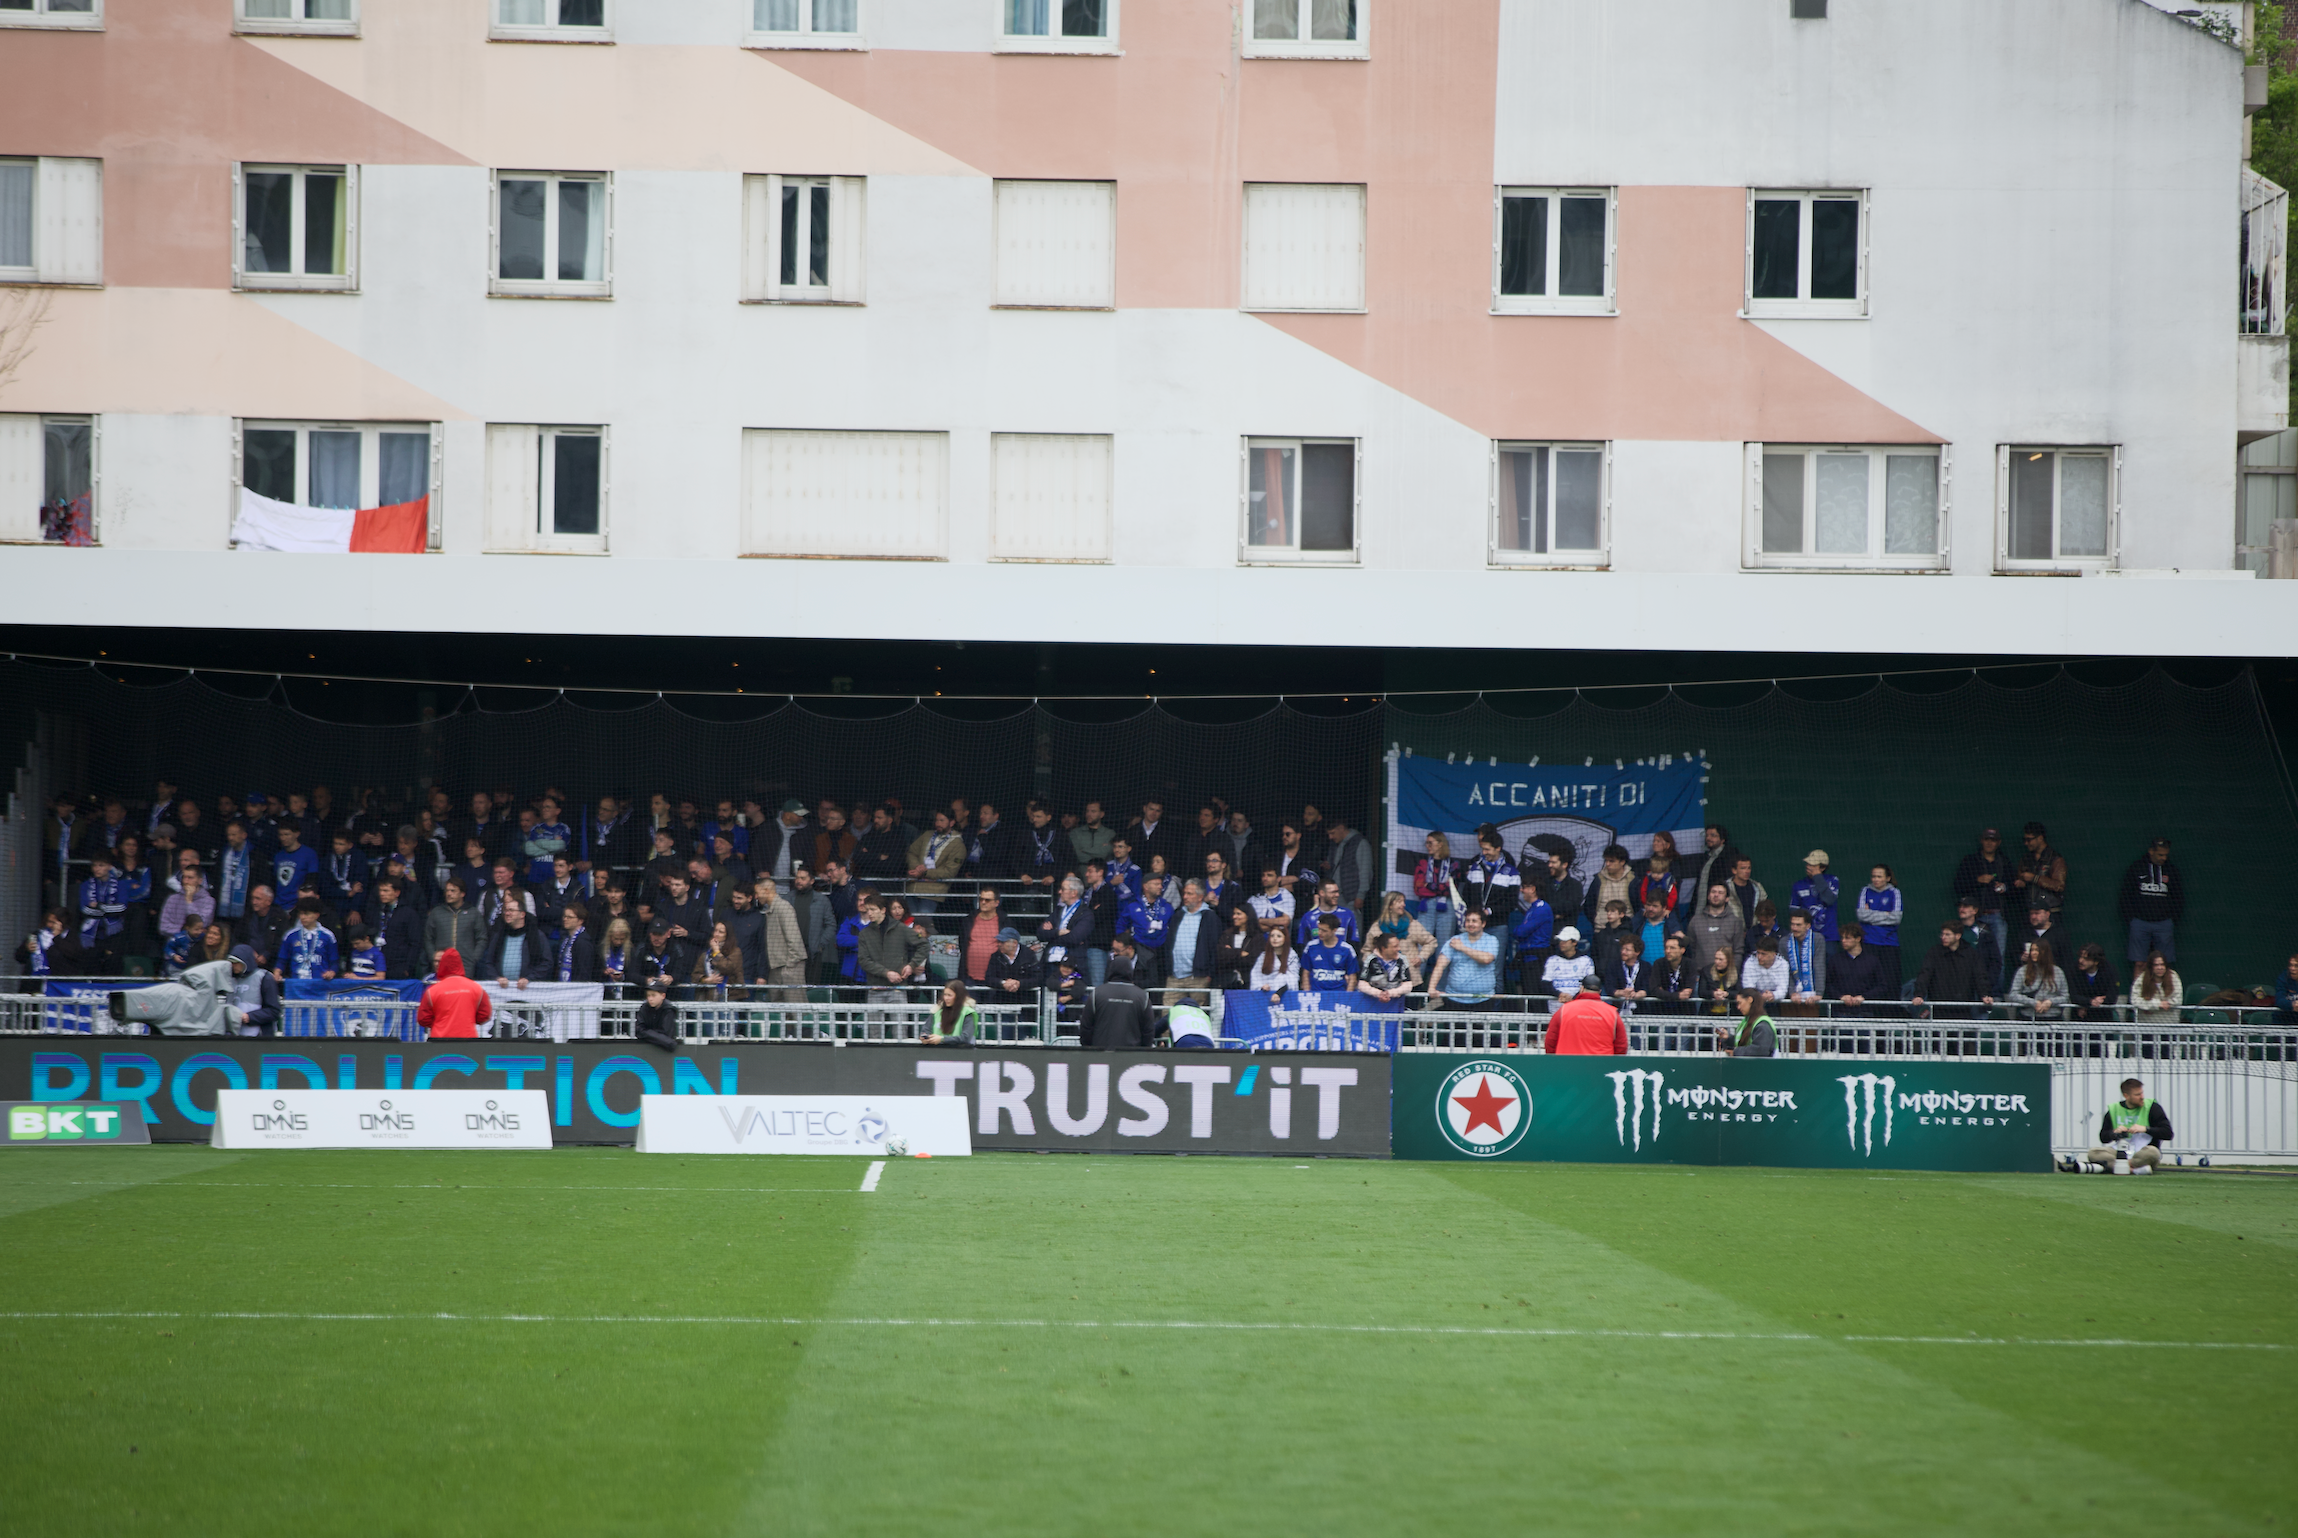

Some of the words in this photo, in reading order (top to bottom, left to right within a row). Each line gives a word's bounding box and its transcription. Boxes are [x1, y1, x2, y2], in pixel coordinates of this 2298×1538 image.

[1468, 782, 1607, 808] ACCANITI
[1619, 781, 1645, 806] DI
[1451, 1067, 1471, 1083] RED
[1475, 1064, 1502, 1074] STAR
[1504, 1071, 1517, 1083] FC
[1667, 1085, 1799, 1110] MONSTER
[1899, 1090, 2031, 1114] MONSTER
[12, 1111, 118, 1133] BKT
[717, 1106, 848, 1144] VALTEC
[1687, 1111, 1778, 1122] ENERGY
[1919, 1116, 2010, 1127] ENERGY
[1473, 1145, 1496, 1154] 1897
